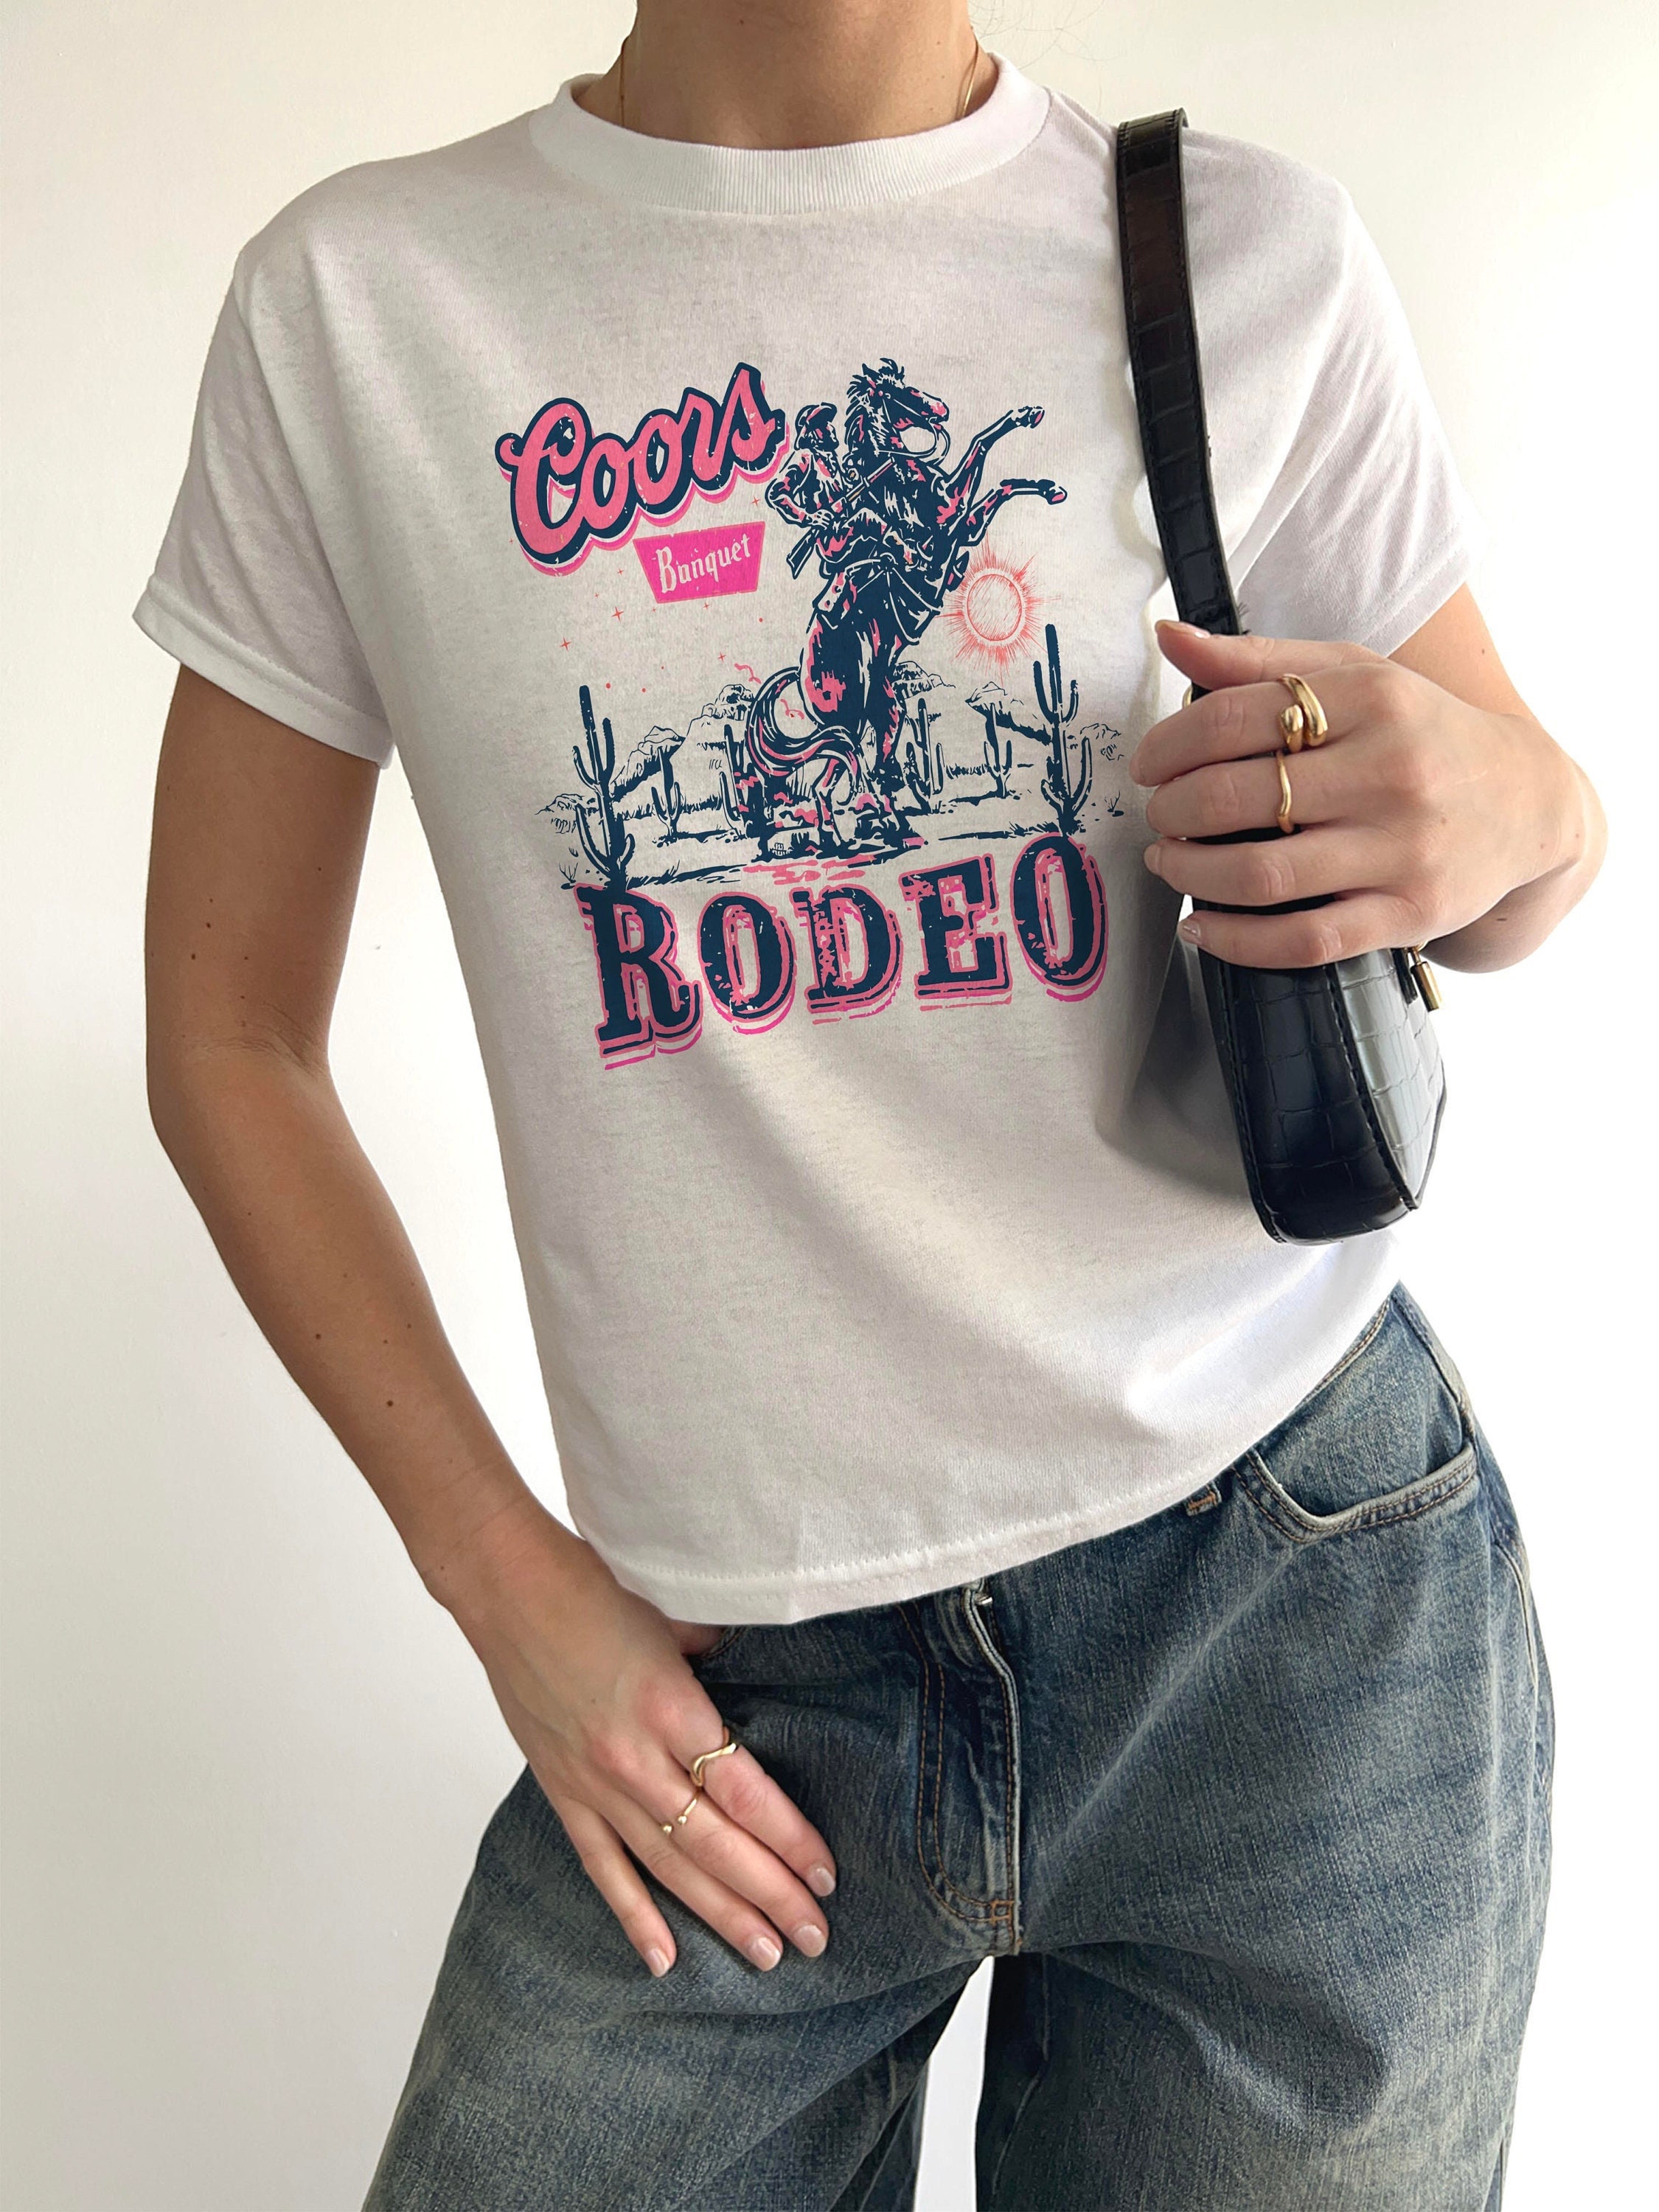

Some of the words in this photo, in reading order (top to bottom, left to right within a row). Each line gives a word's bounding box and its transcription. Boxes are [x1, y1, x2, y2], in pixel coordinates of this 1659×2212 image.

[495, 362, 790, 577] Coors
[653, 532, 752, 594] Banquet
[575, 832, 1107, 1070] RODEO
